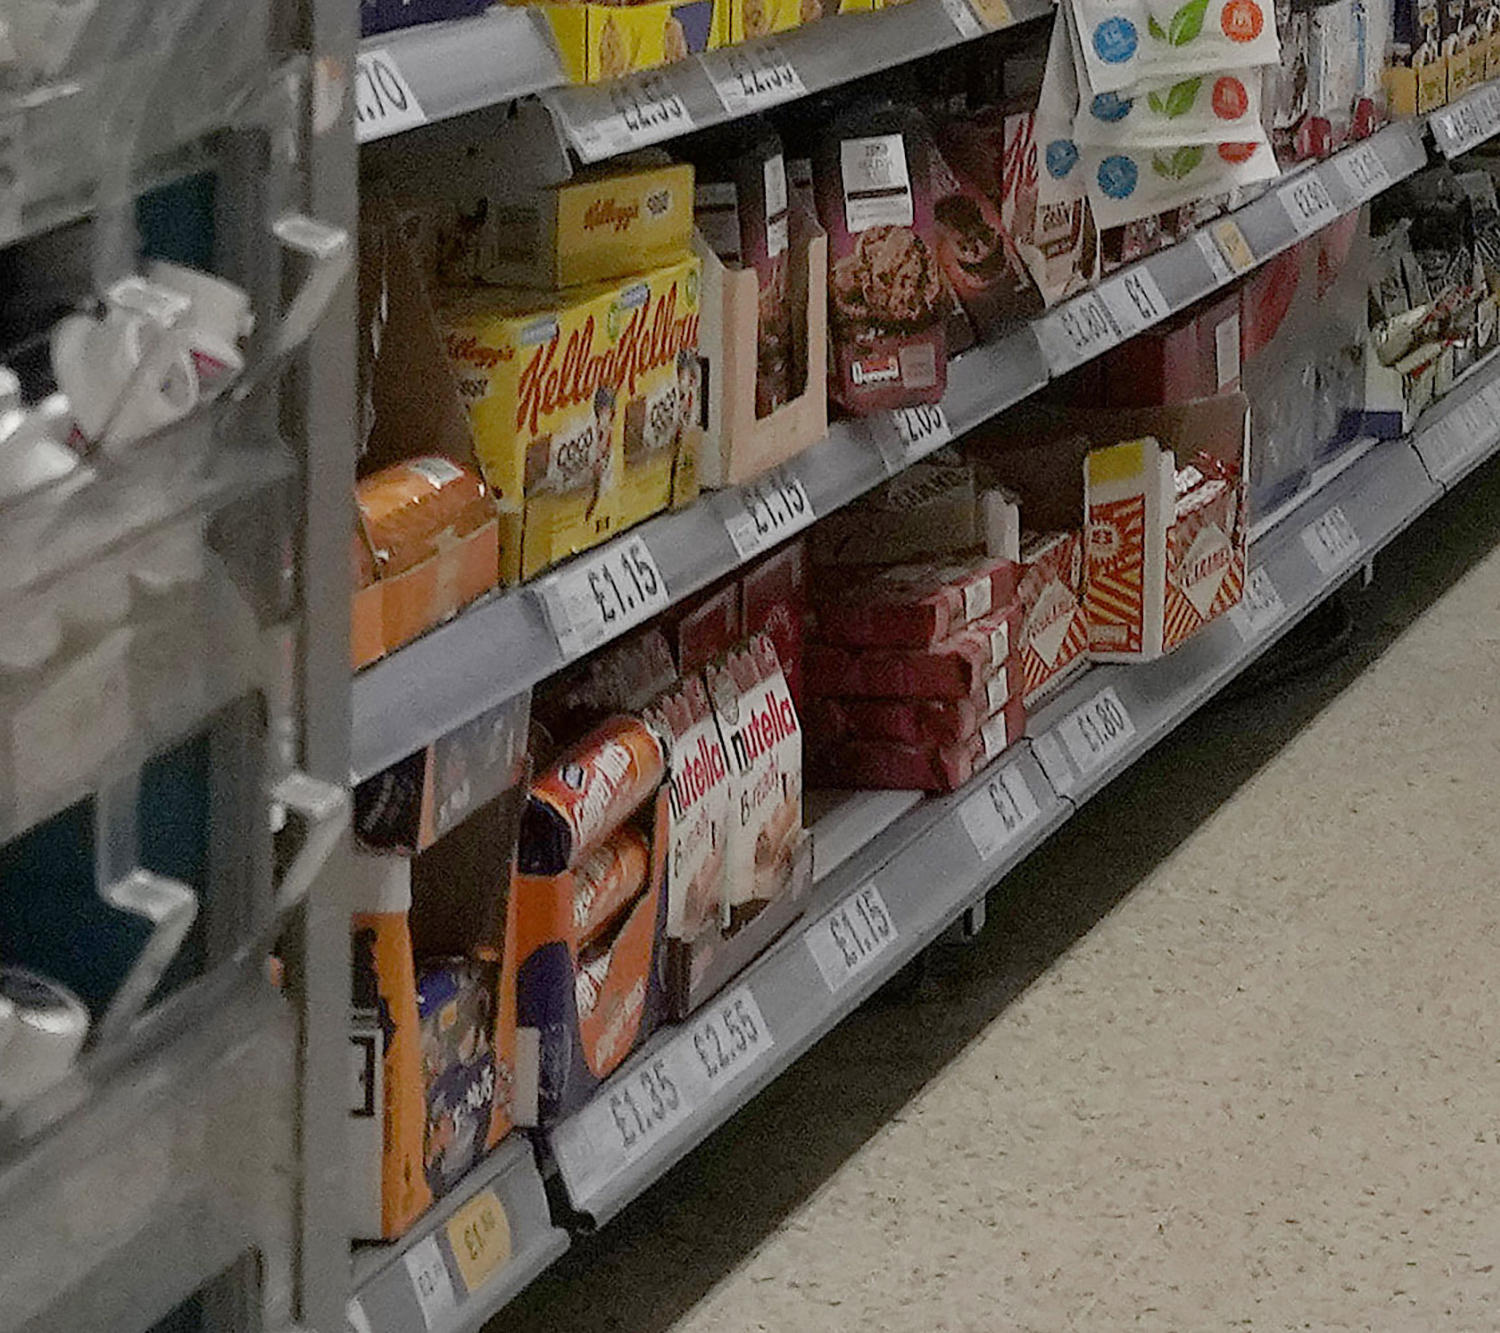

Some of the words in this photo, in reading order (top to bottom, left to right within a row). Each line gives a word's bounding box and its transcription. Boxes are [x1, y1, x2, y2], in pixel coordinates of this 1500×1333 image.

[584, 544, 661, 628] £1.15
[730, 689, 798, 777] nutella
[669, 734, 726, 821] nutella
[836, 885, 890, 971] £1.15
[691, 1002, 761, 1085] £2.55
[608, 1063, 684, 1151] £1.35
